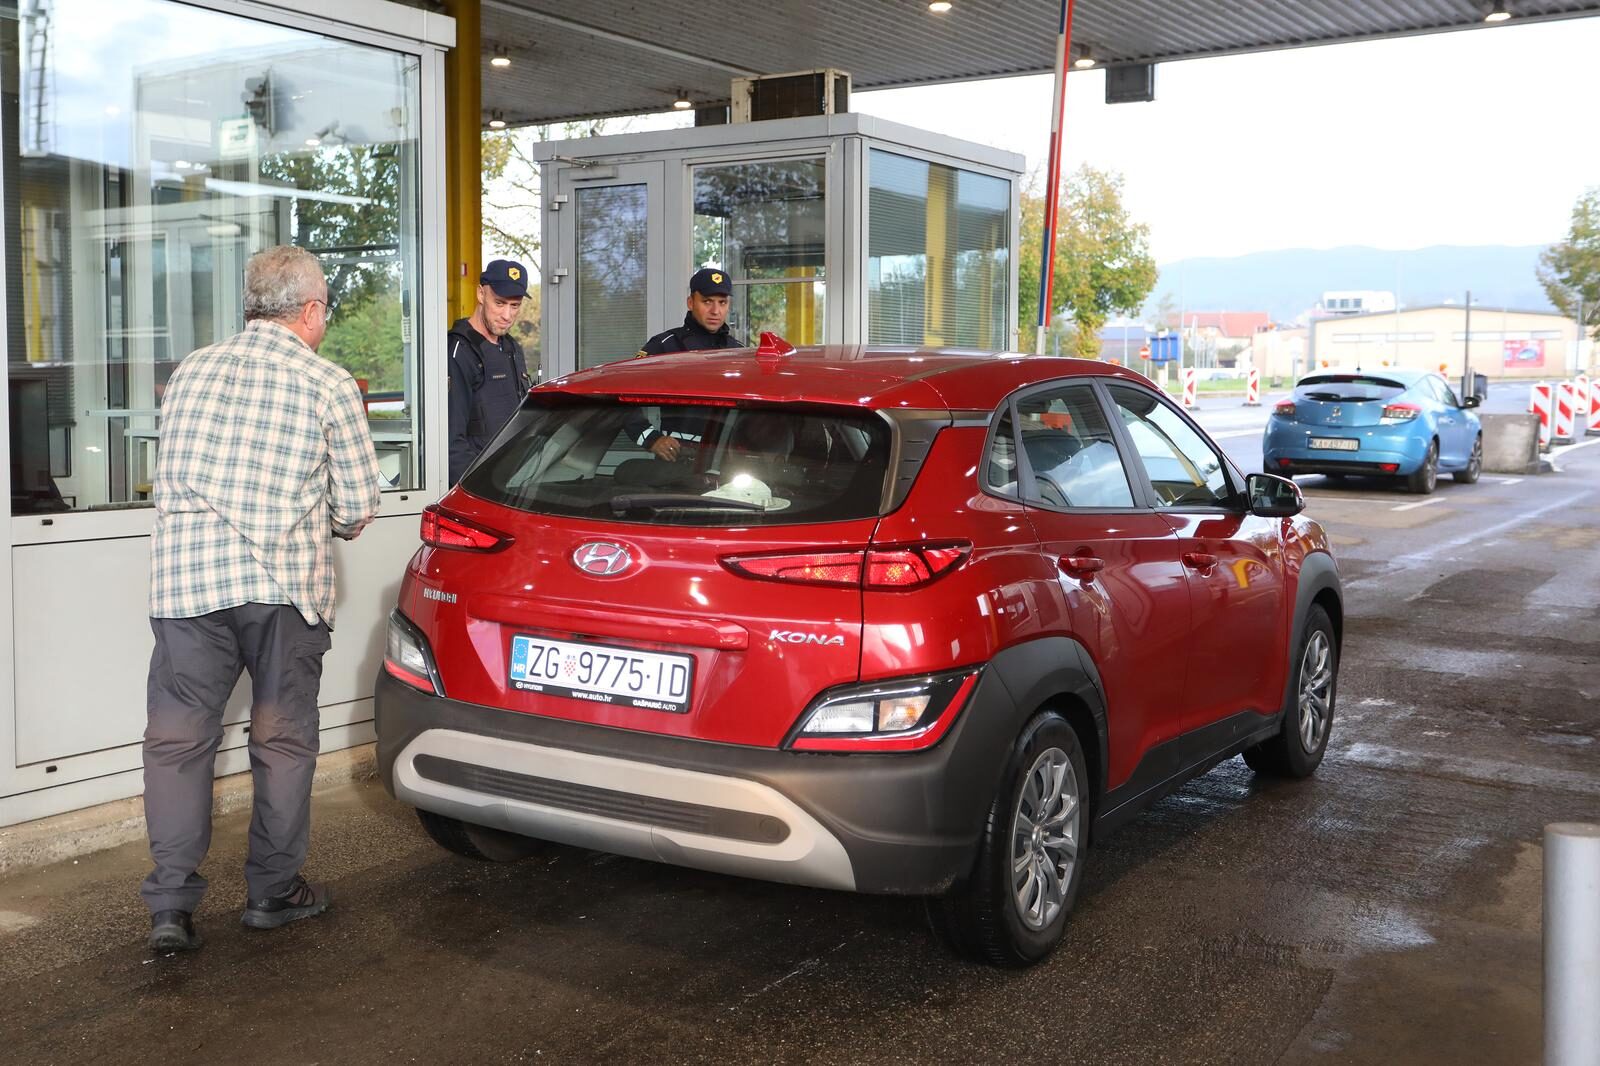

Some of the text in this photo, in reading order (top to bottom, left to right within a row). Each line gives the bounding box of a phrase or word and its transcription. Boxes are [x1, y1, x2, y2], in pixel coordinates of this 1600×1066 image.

[768, 629, 844, 646] KONA
[513, 663, 525, 674] HR
[529, 645, 560, 679] ZG
[572, 690, 612, 703] www.auto.hr
